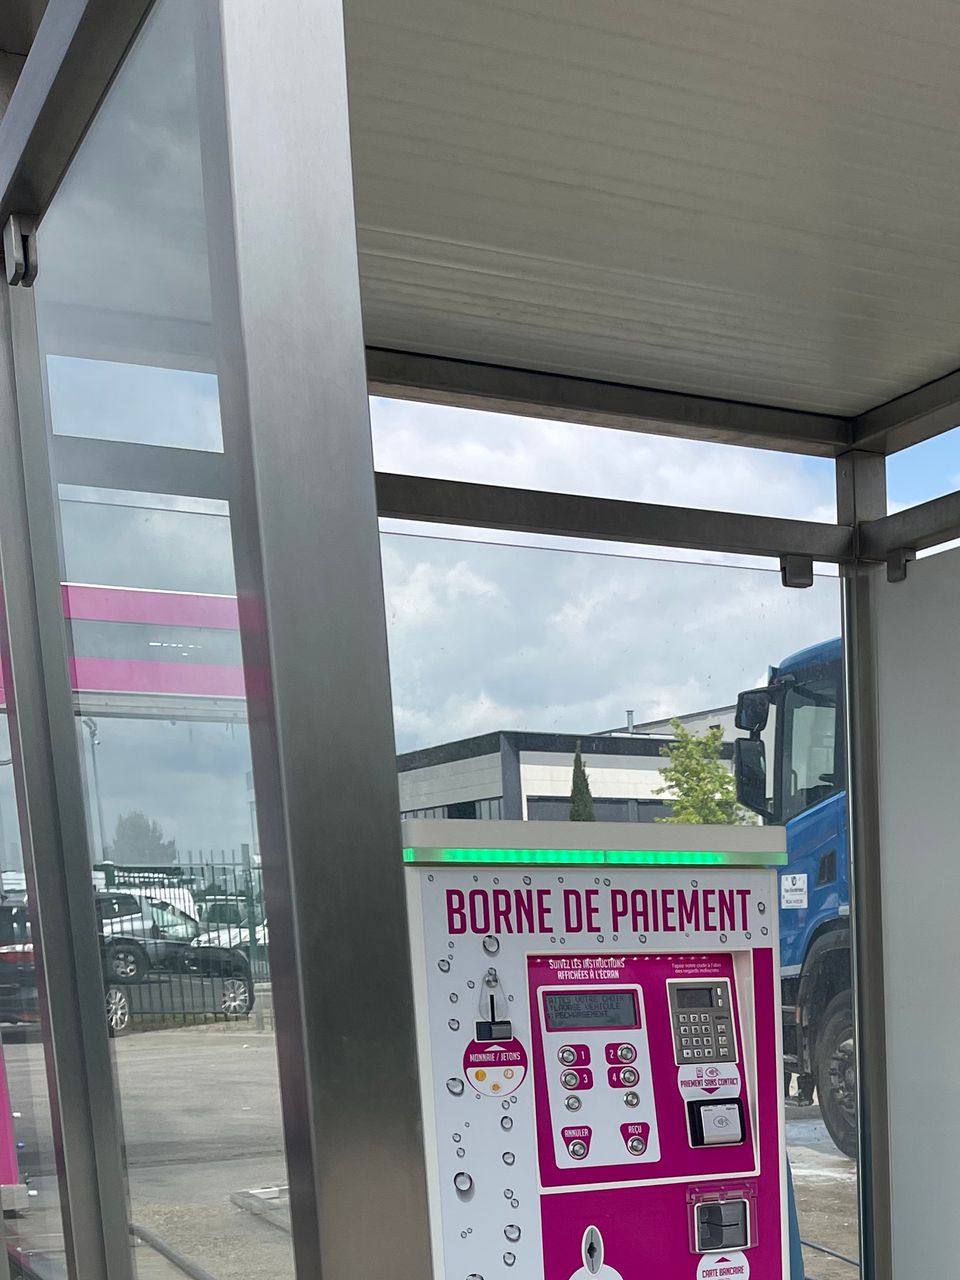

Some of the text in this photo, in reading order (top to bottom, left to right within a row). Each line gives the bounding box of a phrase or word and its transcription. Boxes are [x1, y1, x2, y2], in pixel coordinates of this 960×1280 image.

[445, 889, 751, 934] BORNE DE PAIEMENT
[549, 959, 625, 969] SUIVEZ LES INSTRUCTIONS
[470, 1053, 494, 1062] MONNAIE
[501, 1052, 520, 1061] JETONS
[581, 1050, 614, 1060] 1 2
[583, 1073, 617, 1083] 3 4
[718, 1078, 738, 1086] CONTACT
[565, 1129, 589, 1137] ANNULER
[628, 1125, 642, 1135] REÇU
[702, 1266, 744, 1278] CARTE BANCAIRE
